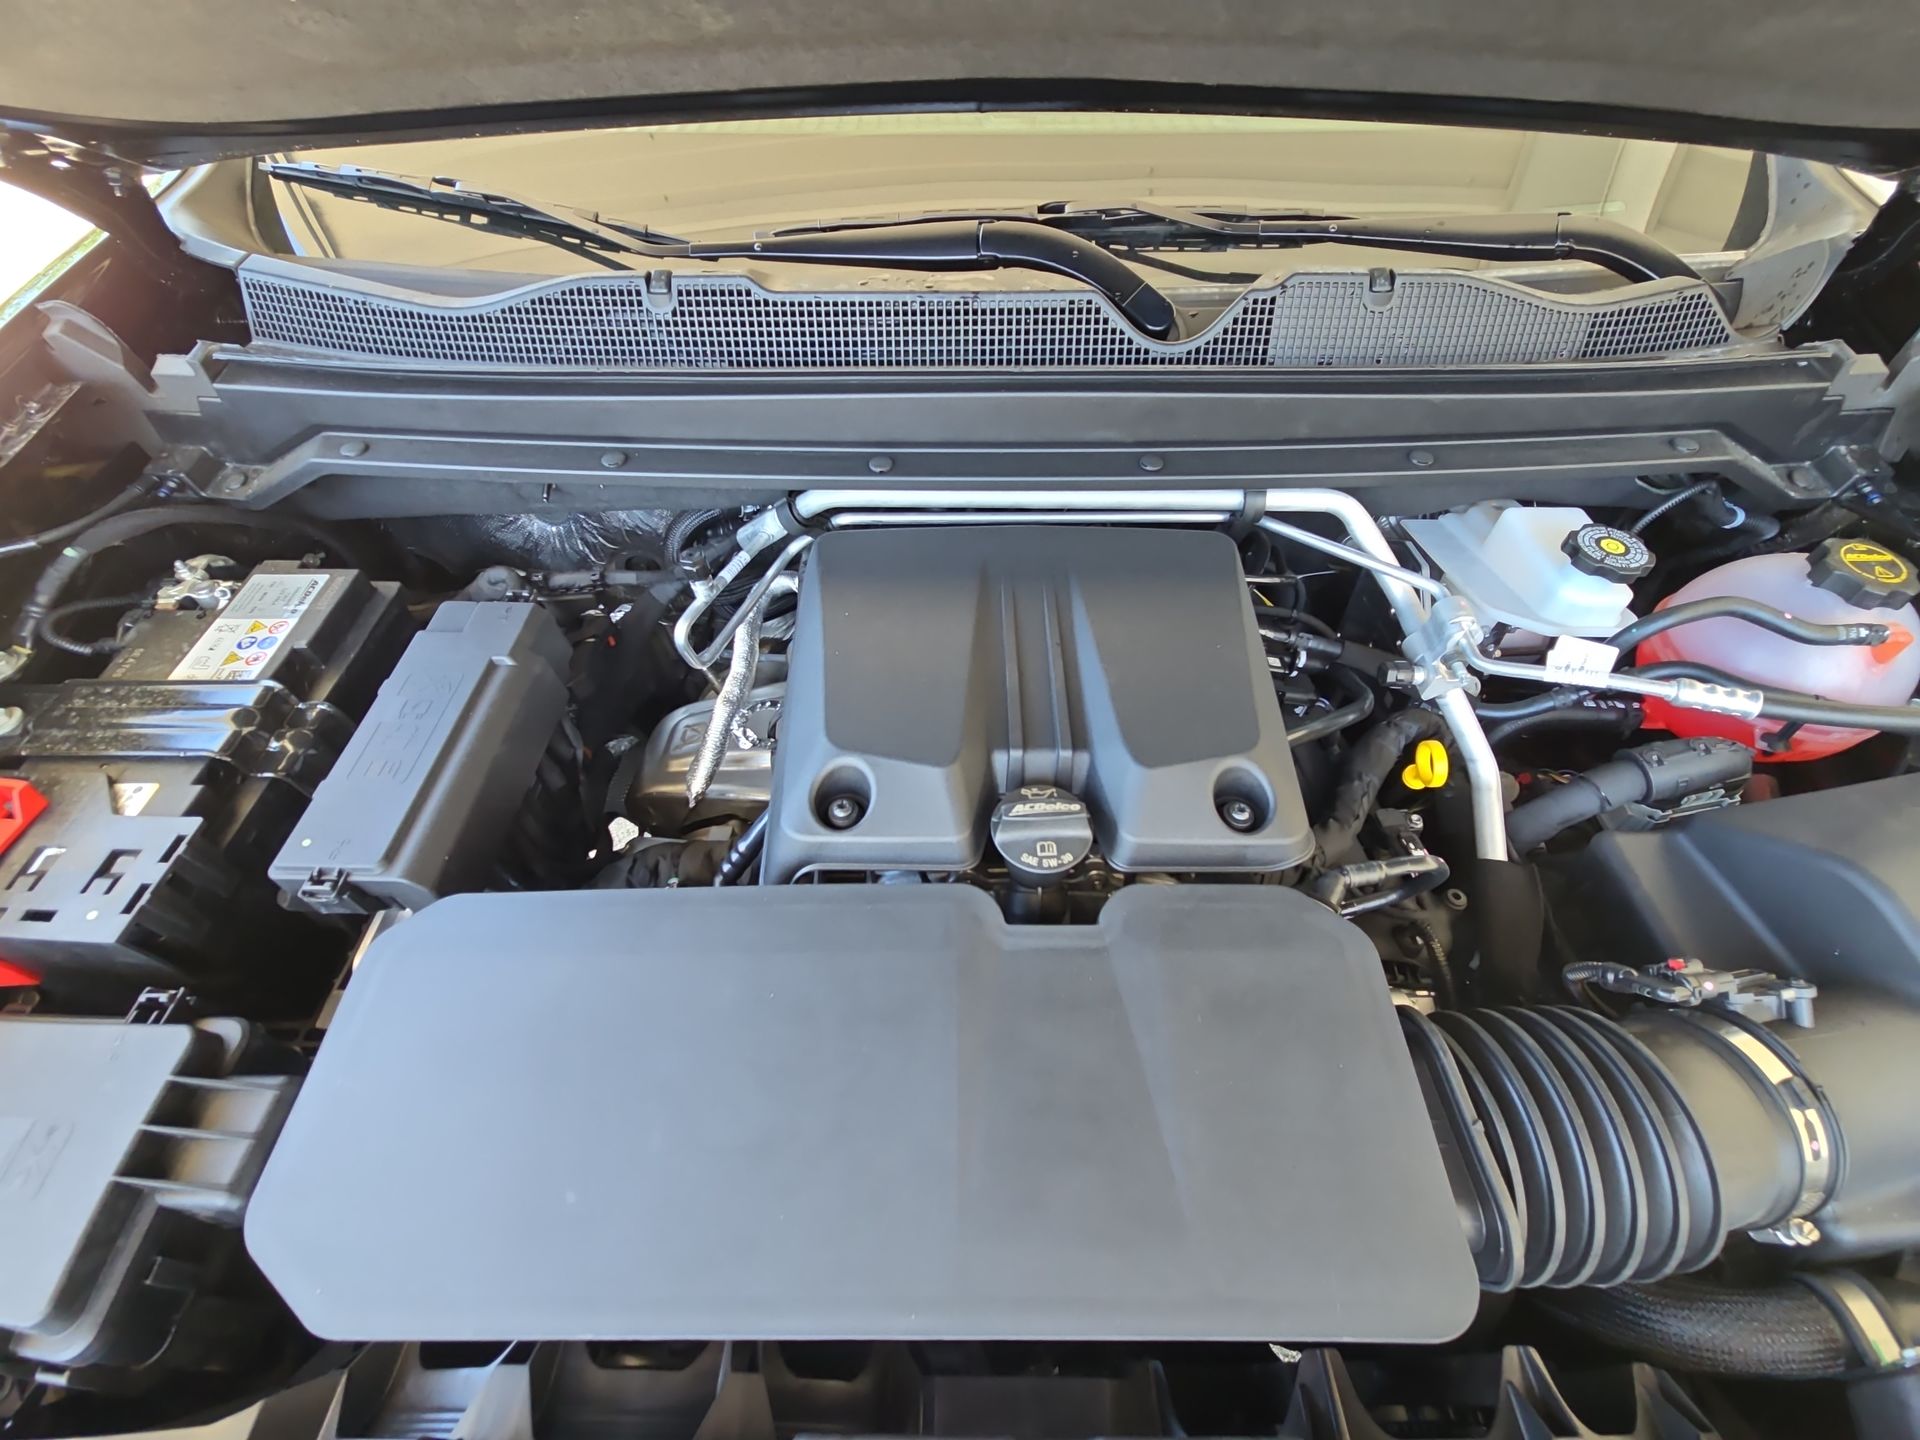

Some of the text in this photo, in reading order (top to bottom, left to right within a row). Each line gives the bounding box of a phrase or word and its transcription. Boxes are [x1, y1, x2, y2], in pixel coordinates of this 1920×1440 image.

[1008, 802, 1081, 816] ACDelco
[1021, 853, 1074, 868] SAE 5W-30
